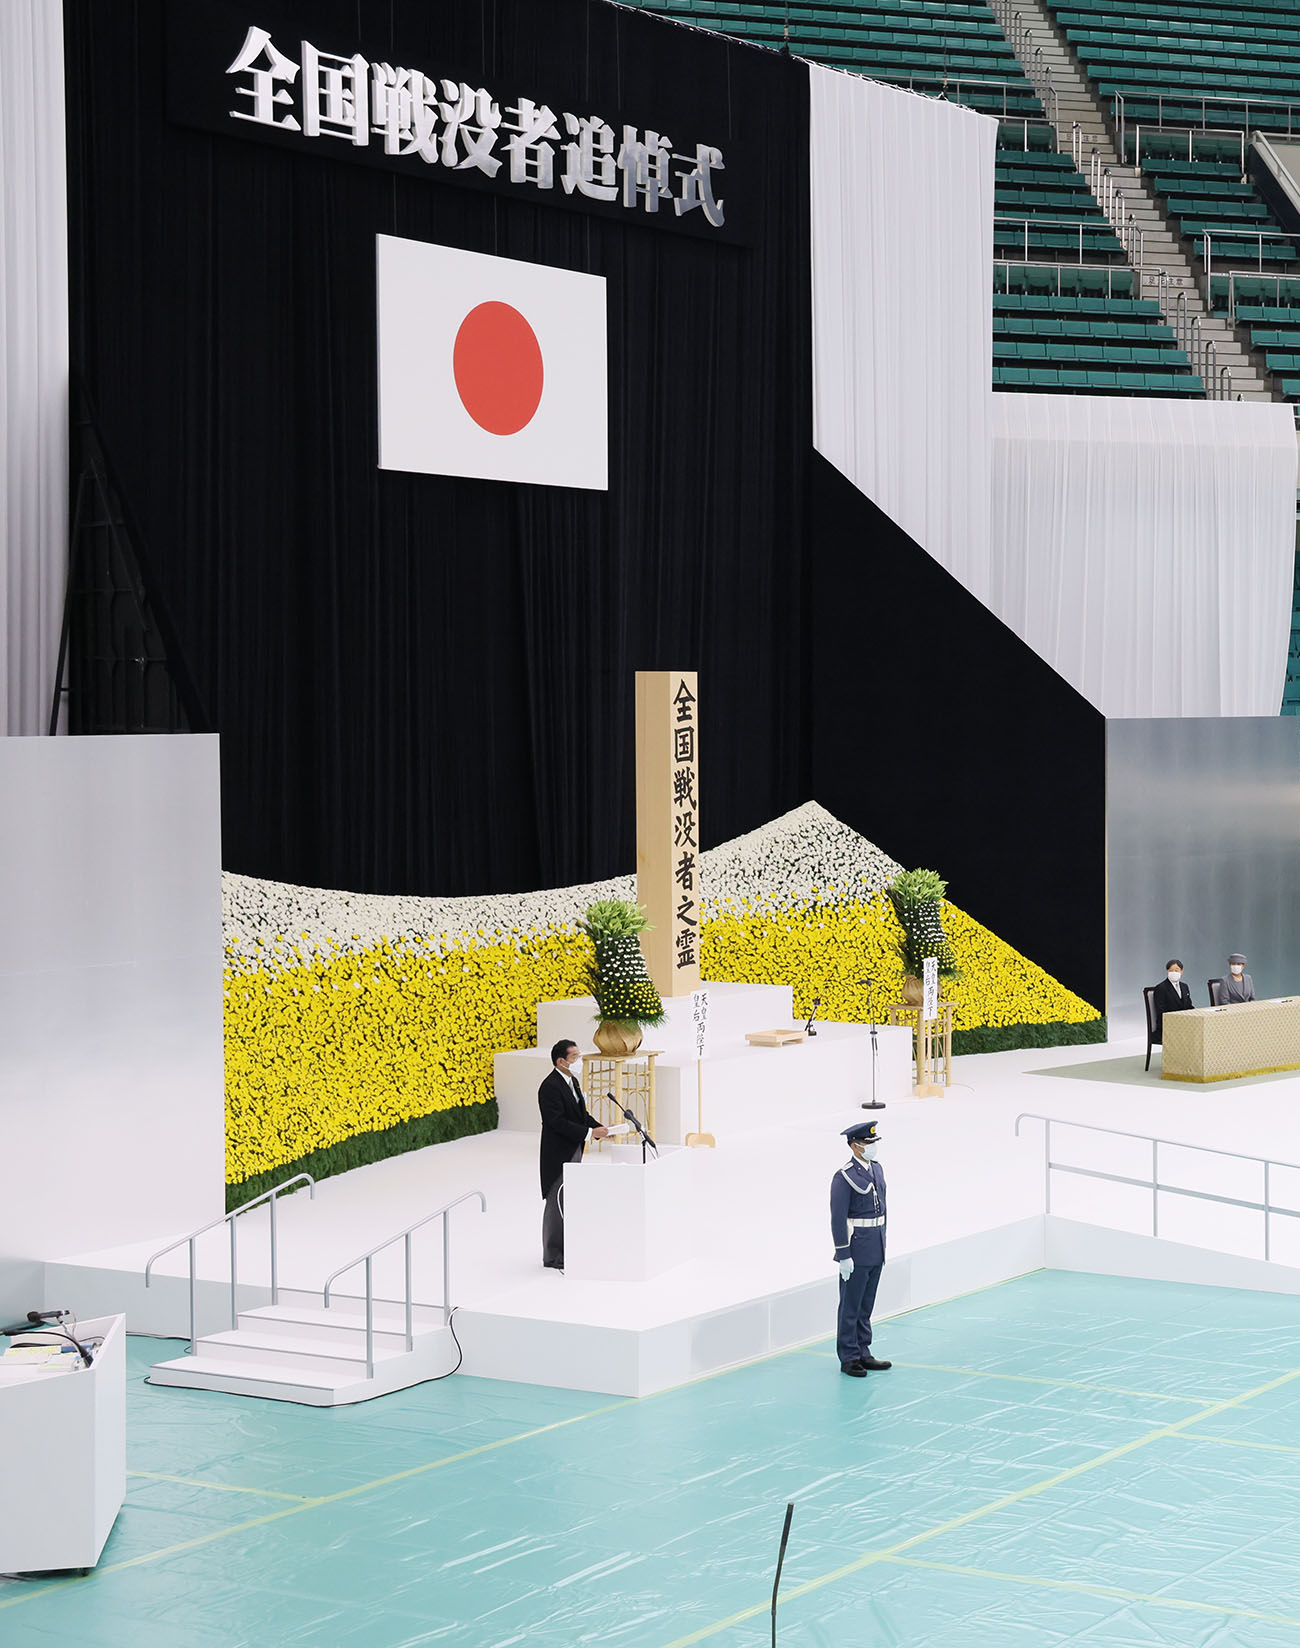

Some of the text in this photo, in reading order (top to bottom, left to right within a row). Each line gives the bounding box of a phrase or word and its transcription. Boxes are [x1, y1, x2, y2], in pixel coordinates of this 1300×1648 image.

[225, 26, 725, 227] 全国戦没者追悼式
[673, 678, 698, 970] 全国戦没者之霊
